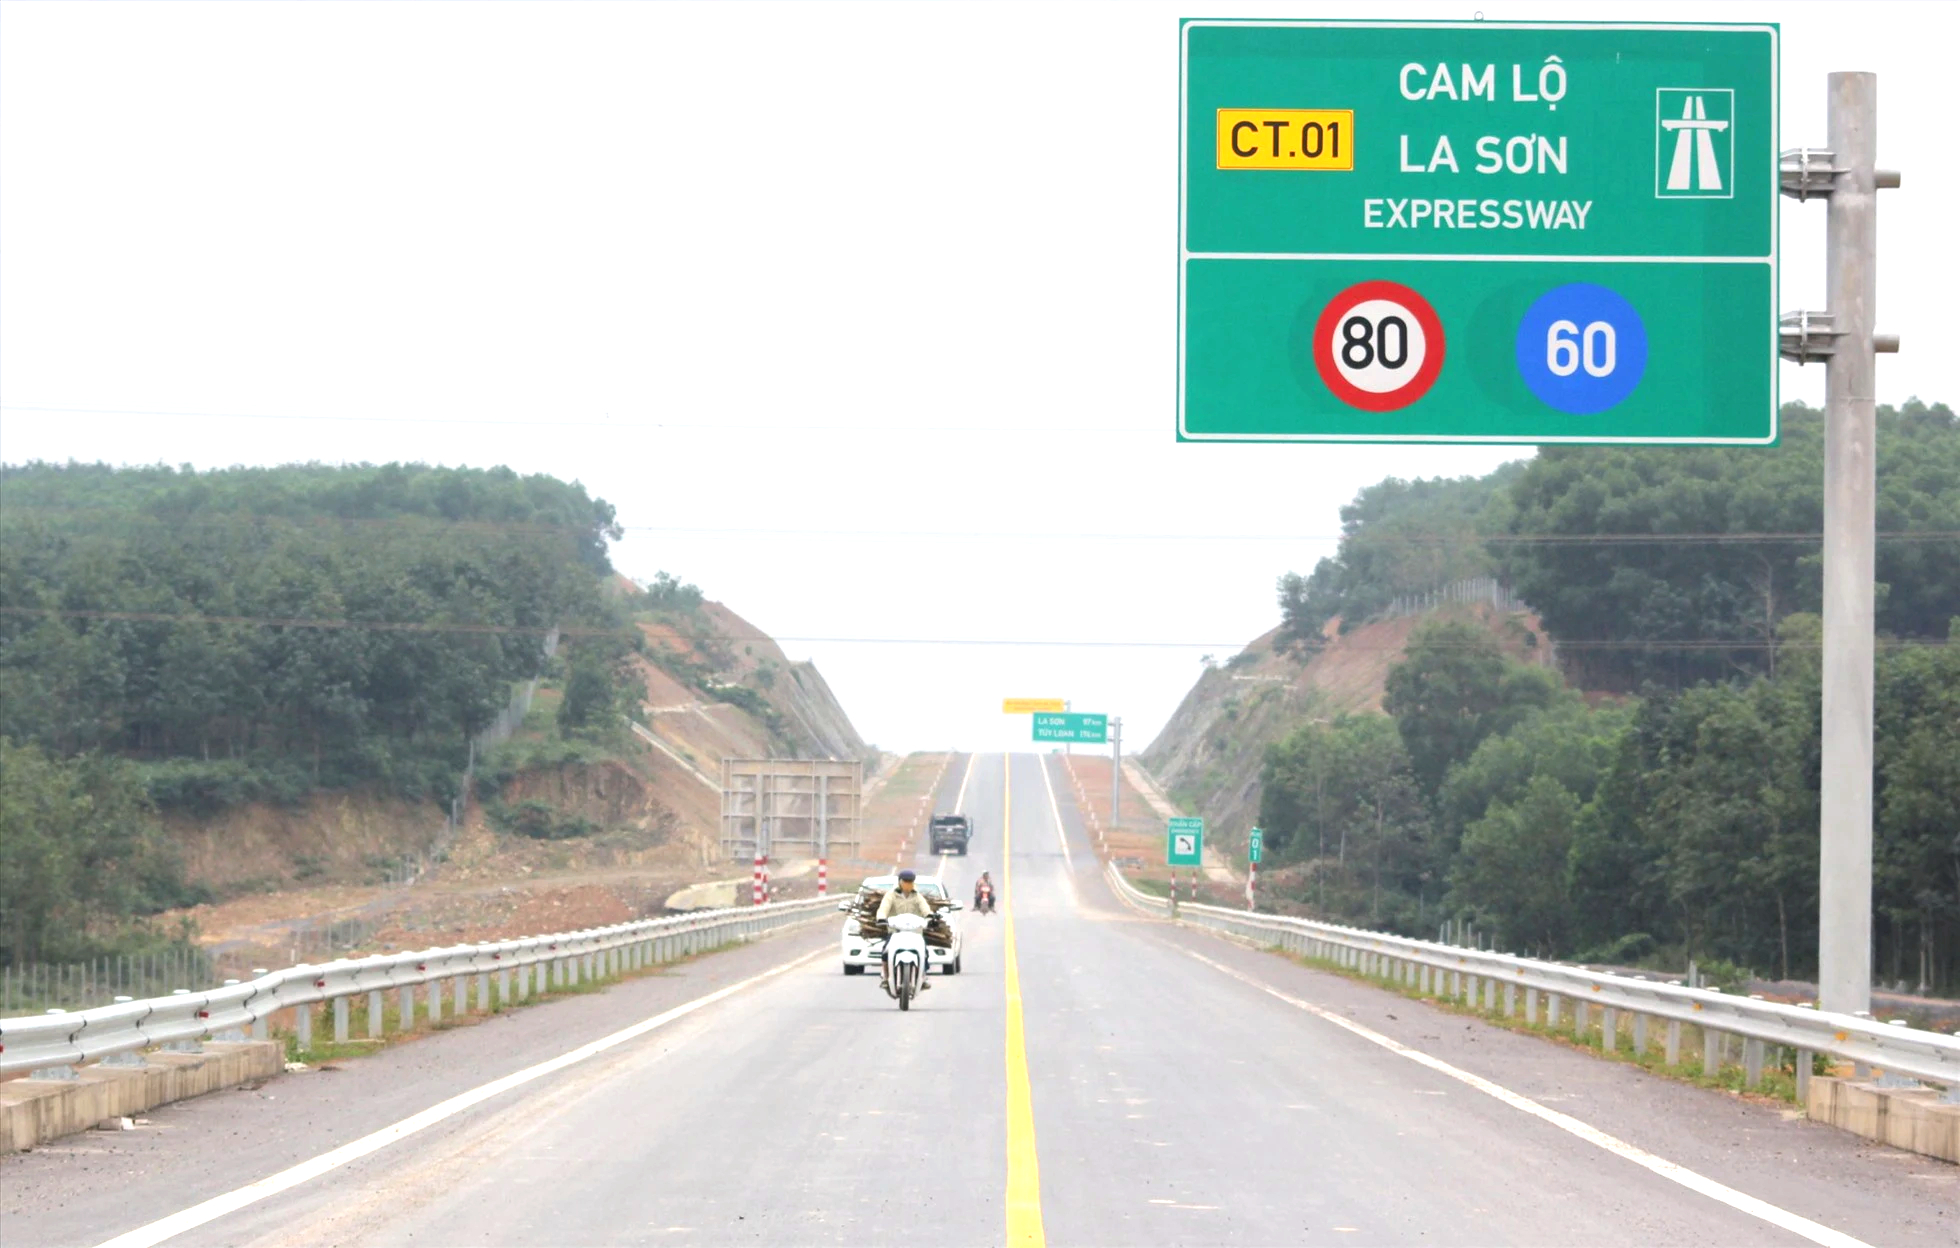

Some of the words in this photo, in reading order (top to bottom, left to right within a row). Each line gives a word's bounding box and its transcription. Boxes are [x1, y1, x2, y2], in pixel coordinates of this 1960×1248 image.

[1399, 63, 1496, 101] CAM
[1512, 54, 1568, 112] LỘ
[1231, 121, 1341, 158] CT.01
[1399, 135, 1459, 174] LA
[1474, 133, 1569, 175] SƠN
[1363, 199, 1594, 230] EXPRESSWAY
[1341, 316, 1409, 370] 80
[1546, 320, 1617, 377] 60
